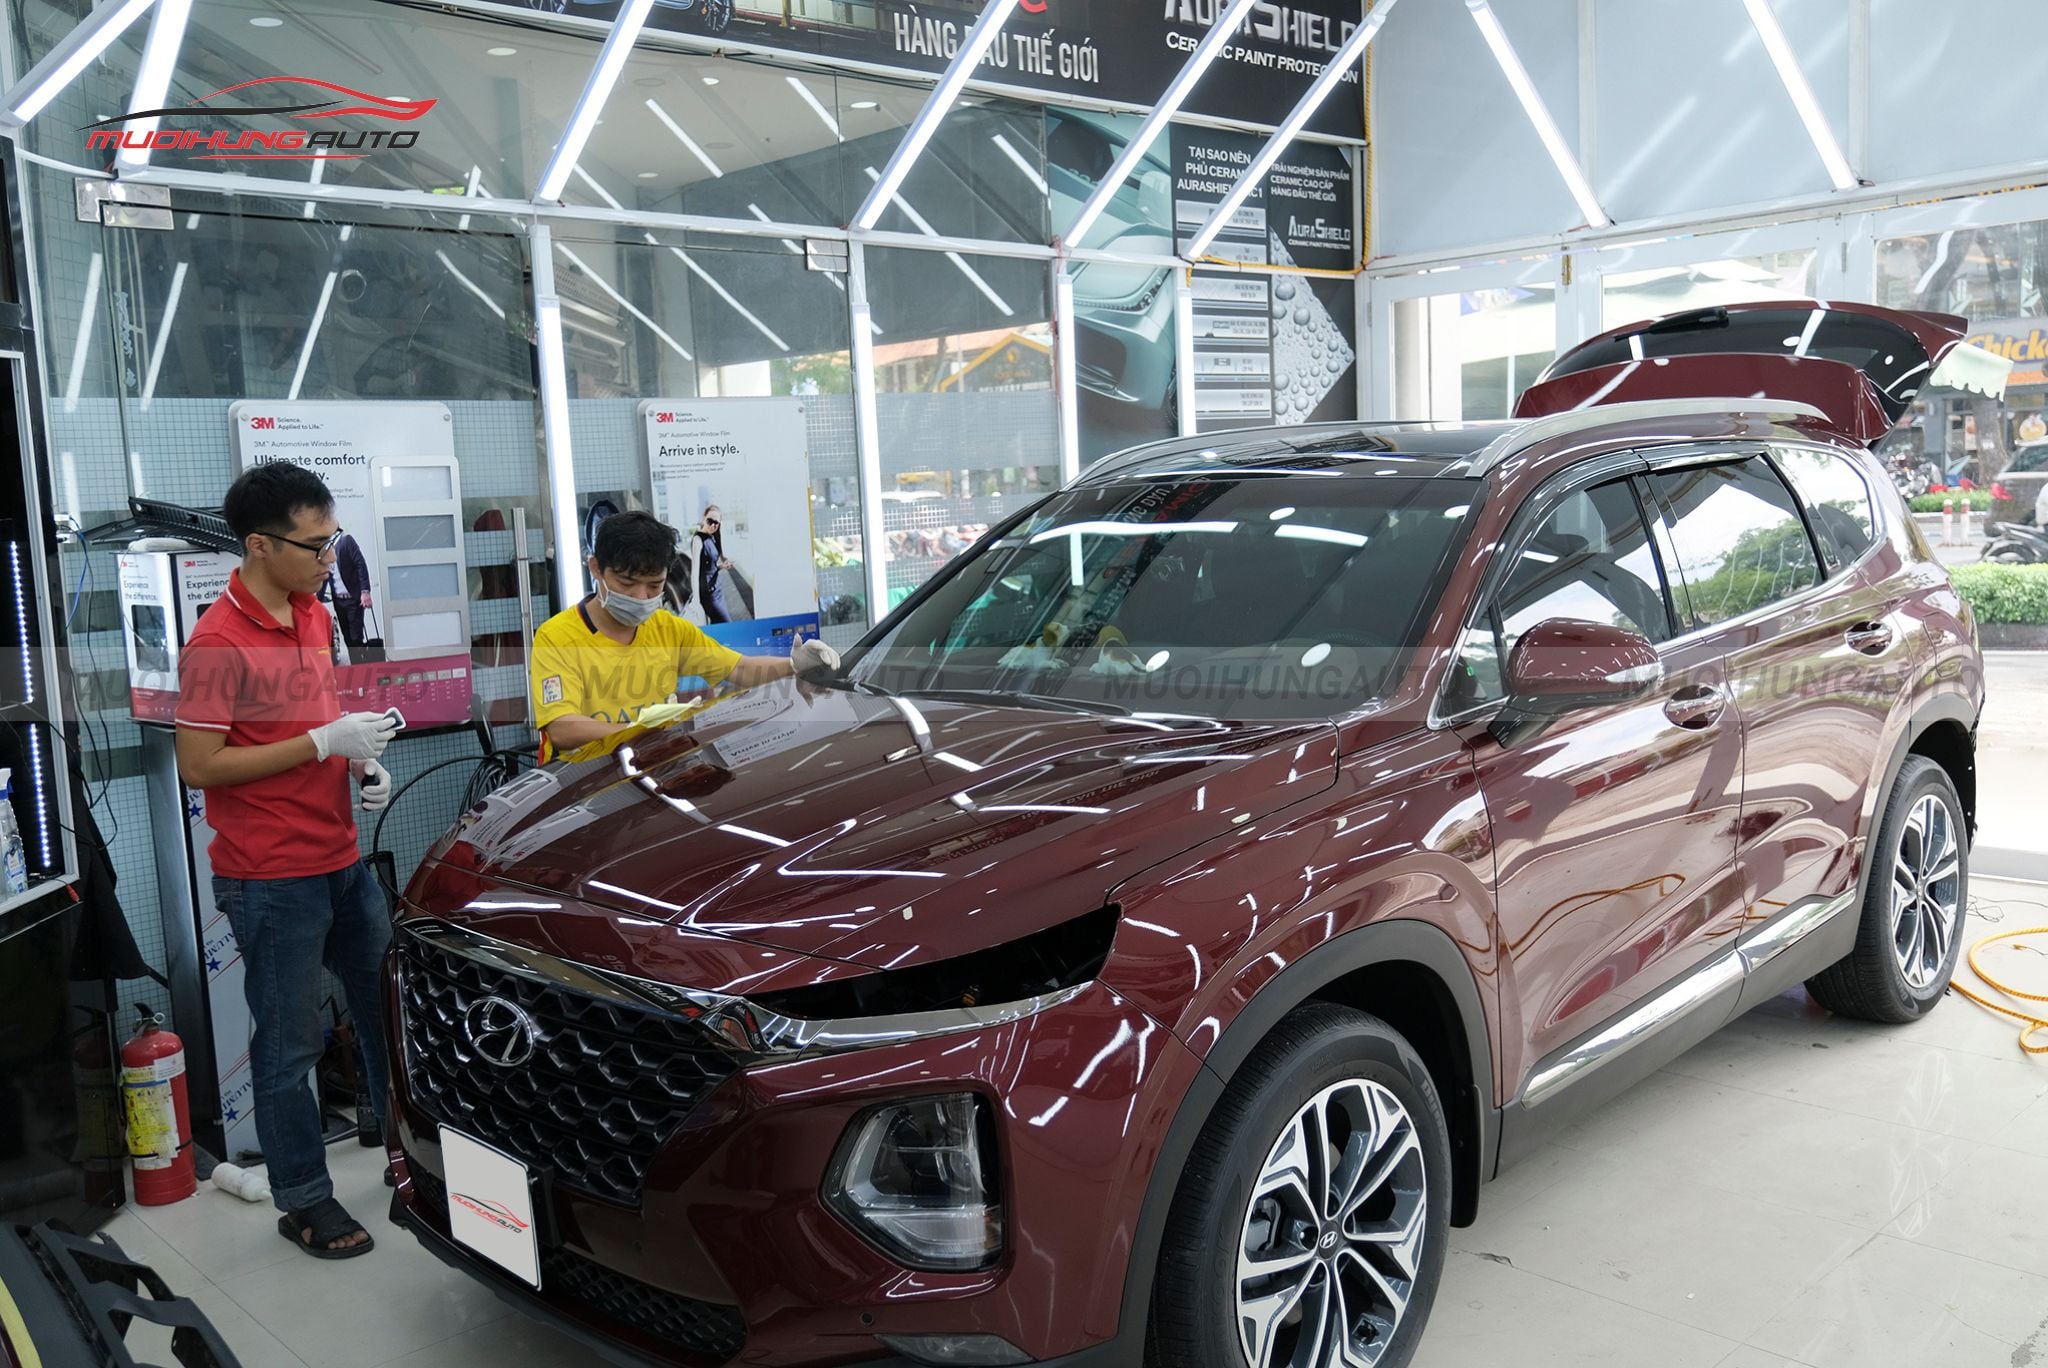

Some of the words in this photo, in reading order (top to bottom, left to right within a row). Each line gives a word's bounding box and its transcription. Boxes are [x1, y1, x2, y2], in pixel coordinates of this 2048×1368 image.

[894, 5, 958, 59] HÀNG
[1013, 29, 1055, 76] THẾ
[1059, 37, 1099, 83] GIỚI
[1235, 48, 1275, 68] PAINT
[1278, 56, 1359, 84] PROTECON
[1188, 146, 1205, 161] TẠI
[1207, 148, 1228, 161] SAO
[1230, 150, 1251, 164] NÊN
[1185, 160, 1208, 175] PHỦ
[1209, 166, 1245, 179] CERAM
[1177, 178, 1232, 194] AURASHIE
[1270, 175, 1303, 186] CERAMIC
[1303, 179, 1318, 189] CAO
[1319, 179, 1334, 190] CẤP
[1270, 185, 1291, 197] HÀNG
[251, 417, 275, 430] 3M
[656, 412, 674, 423] 3M
[659, 444, 695, 457] Arrive
[697, 443, 707, 455] in
[710, 443, 740, 457] style.
[314, 454, 366, 465] comfort
[187, 591, 202, 600] the
